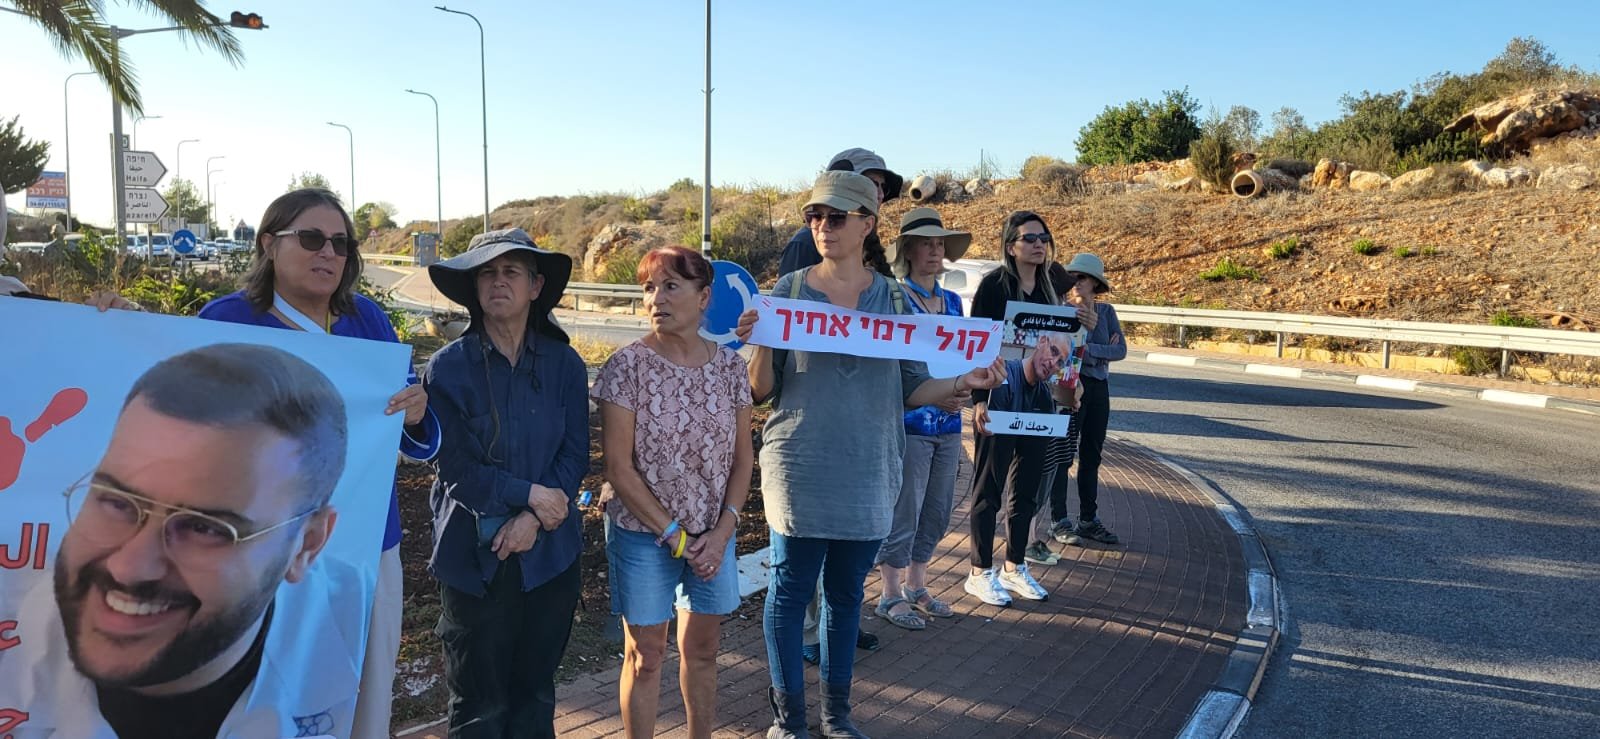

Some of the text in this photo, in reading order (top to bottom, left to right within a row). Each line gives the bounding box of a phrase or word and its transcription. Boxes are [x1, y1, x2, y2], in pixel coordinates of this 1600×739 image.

[127, 155, 146, 164] חיפה
[126, 175, 148, 183] Haifa
[129, 192, 148, 200] נצרת
[860, 316, 916, 344] דמי
[1025, 421, 1053, 435] رحمك
